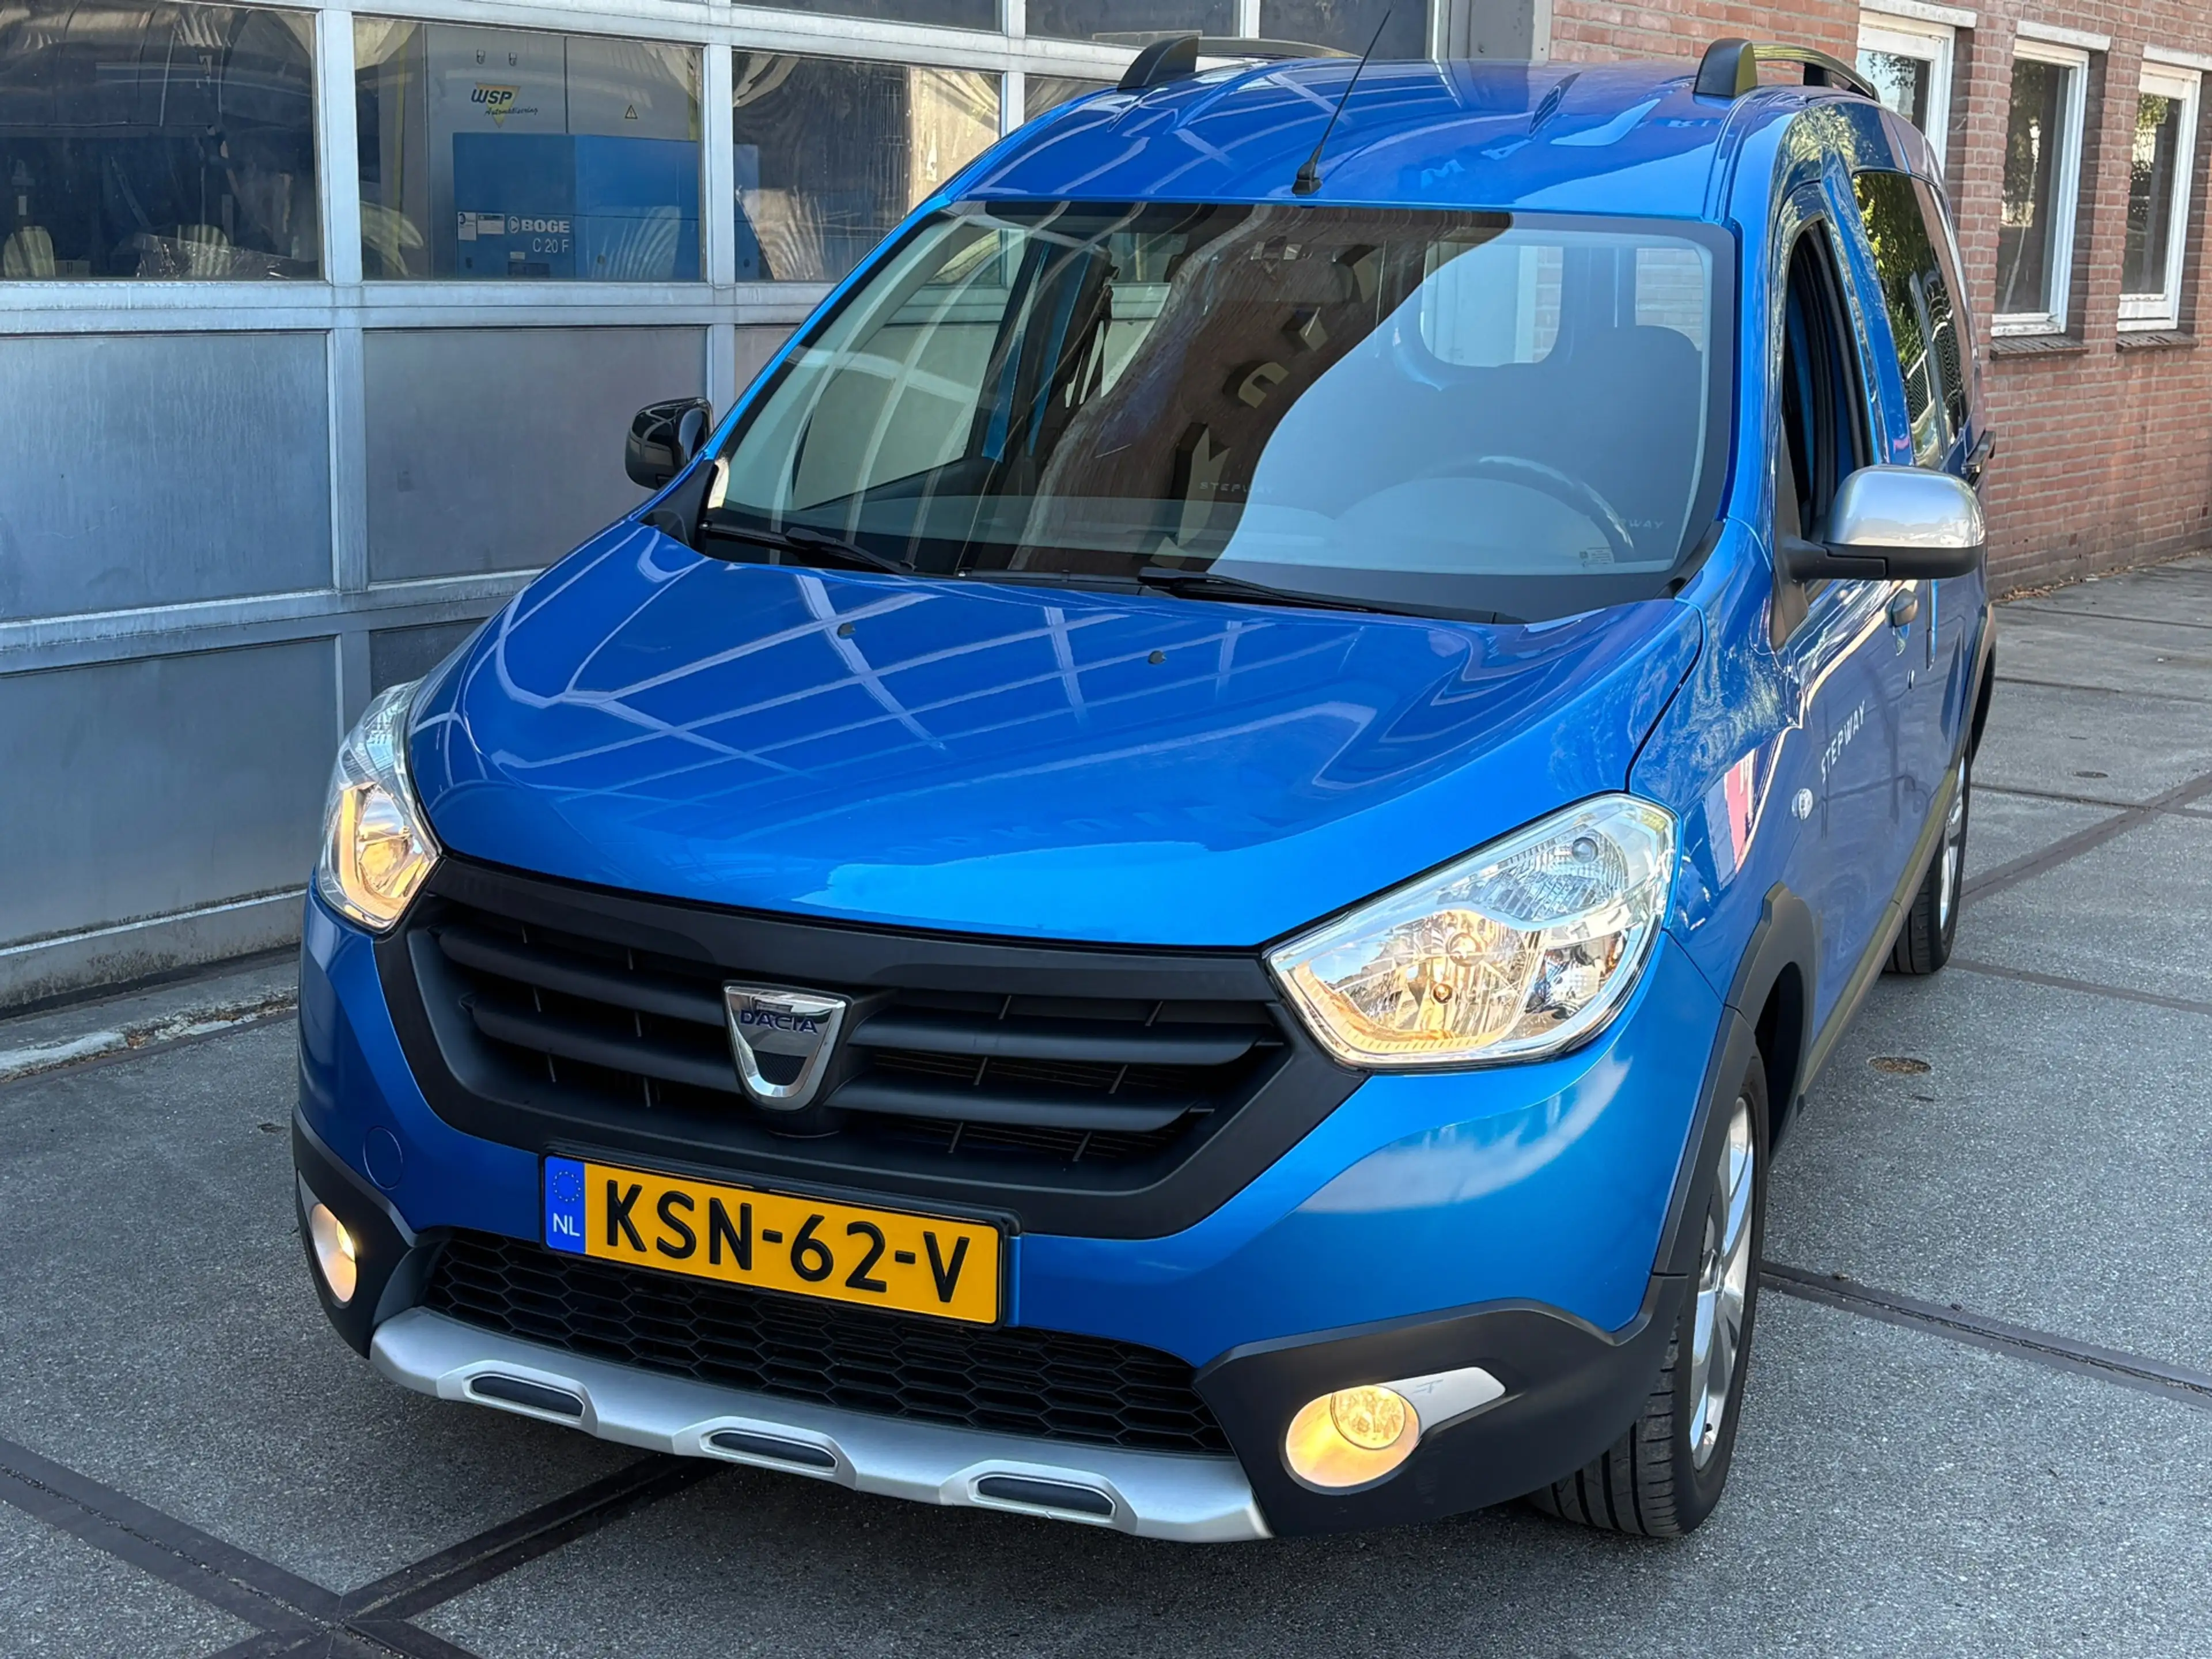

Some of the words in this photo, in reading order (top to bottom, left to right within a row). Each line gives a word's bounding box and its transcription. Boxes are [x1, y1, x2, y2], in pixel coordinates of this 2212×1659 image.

[471, 89, 513, 105] WSP
[521, 219, 570, 233] BOGE
[533, 238, 541, 252] C
[545, 238, 559, 253] 20
[562, 239, 570, 253] F
[1821, 700, 1866, 784] STEPWAY
[740, 1009, 819, 1035] DACIA
[552, 1213, 581, 1237] NL
[606, 1179, 971, 1304] KSN-62-V
